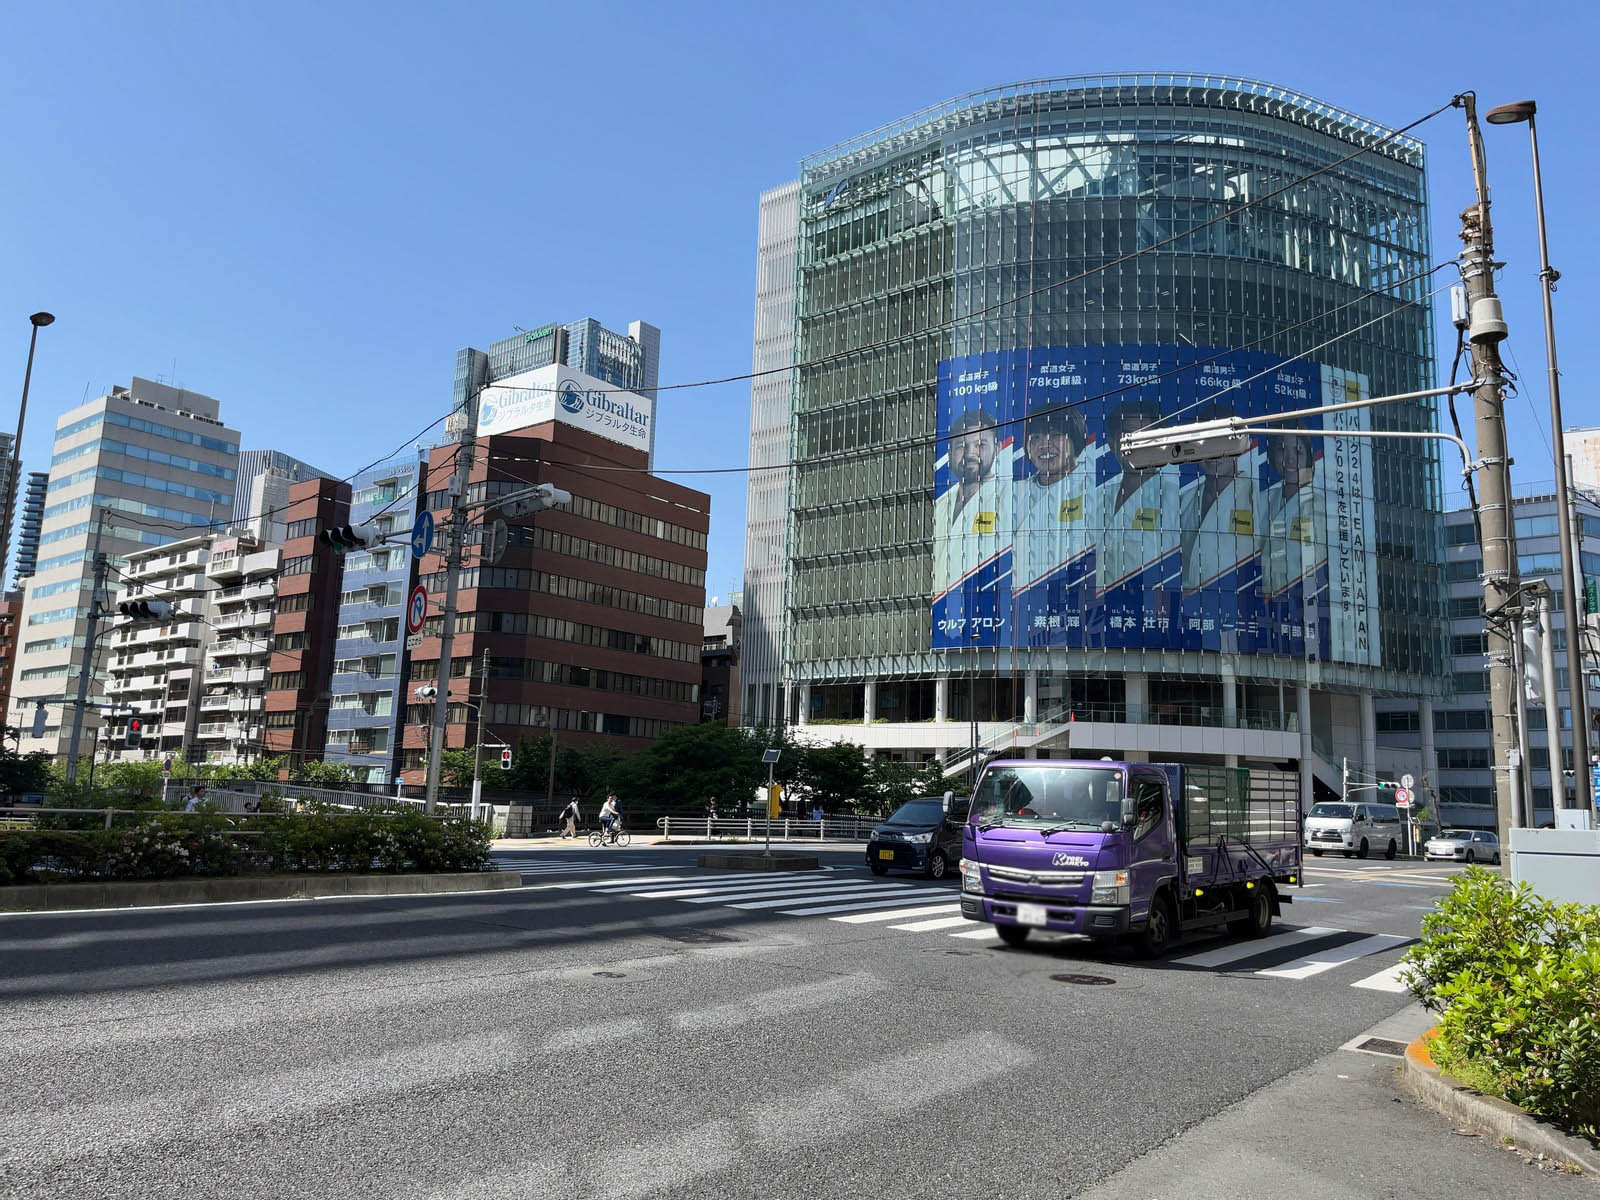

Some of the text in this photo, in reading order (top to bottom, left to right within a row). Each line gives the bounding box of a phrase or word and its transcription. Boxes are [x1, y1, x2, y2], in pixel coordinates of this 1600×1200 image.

[586, 388, 649, 427] Gibraltar
[585, 409, 647, 439] ジブラルタ生命
[937, 617, 1006, 631] ウルフ アロン
[1109, 616, 1137, 628] 橋本
[1188, 618, 1215, 631] 阿部
